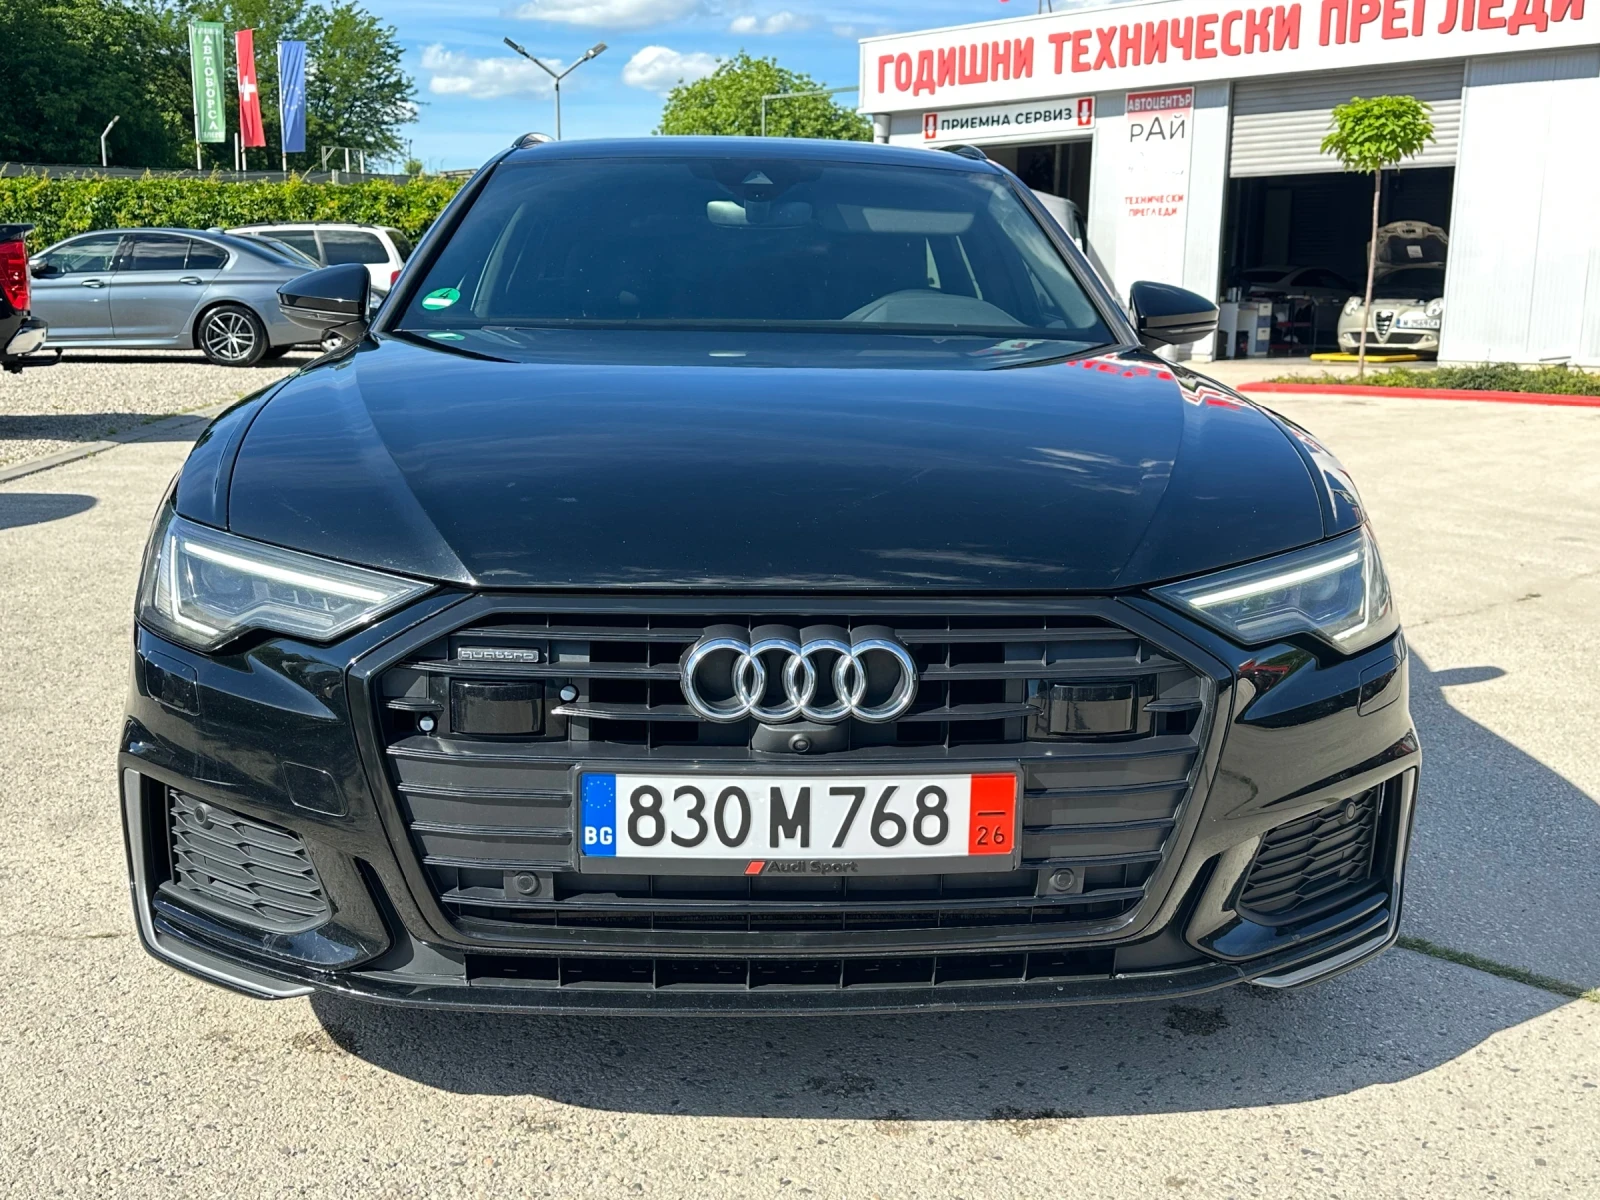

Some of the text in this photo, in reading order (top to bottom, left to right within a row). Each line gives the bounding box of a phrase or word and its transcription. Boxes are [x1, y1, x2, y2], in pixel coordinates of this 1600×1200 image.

[877, 36, 1034, 97] ГОДИШНИ
[1048, 3, 1302, 75] ТЕХНИЧЕСКИ
[202, 34, 219, 130] АВТОБОРСА
[1127, 94, 1192, 111] АВТОЦЕНТЪР
[941, 107, 1073, 131] ПРИЕМНА СЕРВИЗ
[1129, 114, 1186, 143] РАЙ
[1125, 193, 1184, 204] ТЕХНИЧЕСКИ
[1128, 207, 1178, 217] ПРЕГЛЕДИ
[461, 650, 535, 660] quattro
[627, 785, 950, 849] 830 M 768
[584, 826, 613, 846] BG
[977, 826, 1006, 846] 26
[767, 860, 859, 876] Audi Sport
